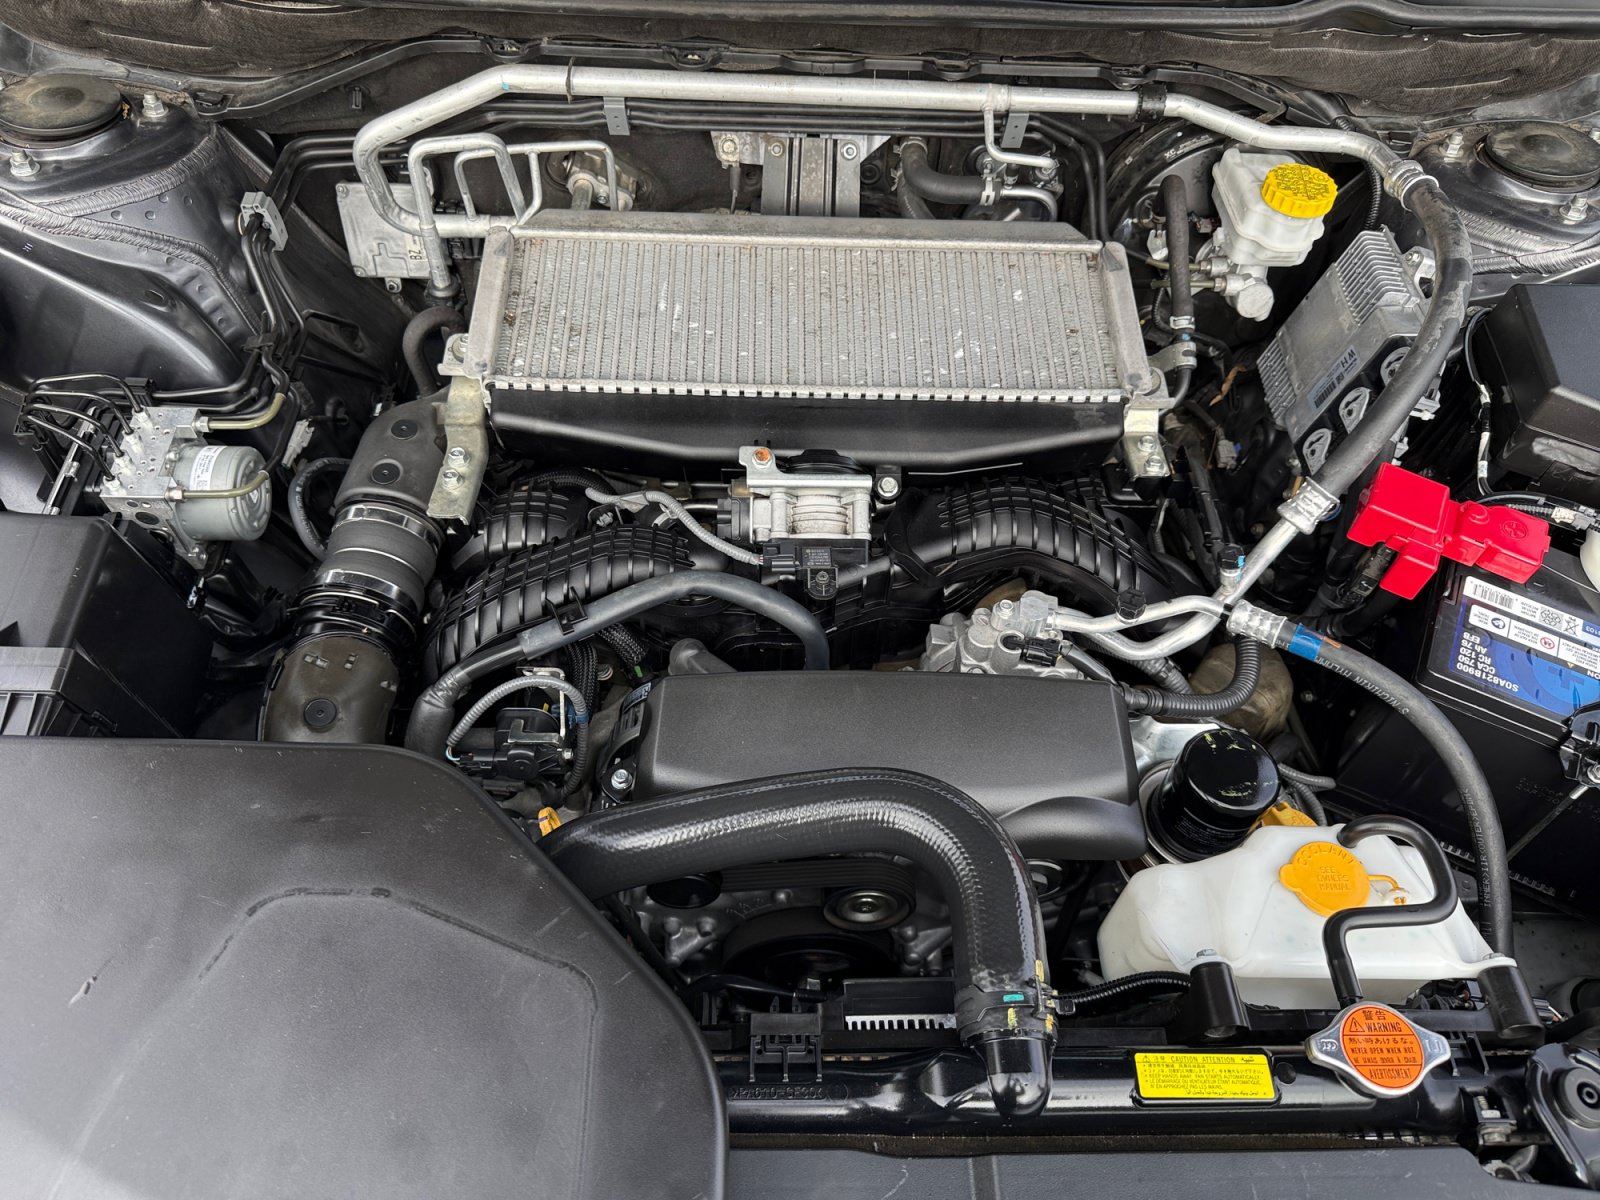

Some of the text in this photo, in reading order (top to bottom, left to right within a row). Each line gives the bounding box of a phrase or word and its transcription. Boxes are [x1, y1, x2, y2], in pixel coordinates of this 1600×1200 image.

[1462, 631, 1481, 644] EFB
[1460, 639, 1487, 654] Ah 76
[1459, 646, 1492, 665] RC 120
[1457, 654, 1496, 674] CCA 750
[1362, 1010, 1387, 1021] 警告
[1364, 1022, 1402, 1033] WARNING
[1202, 1056, 1236, 1064] ATTENTION
